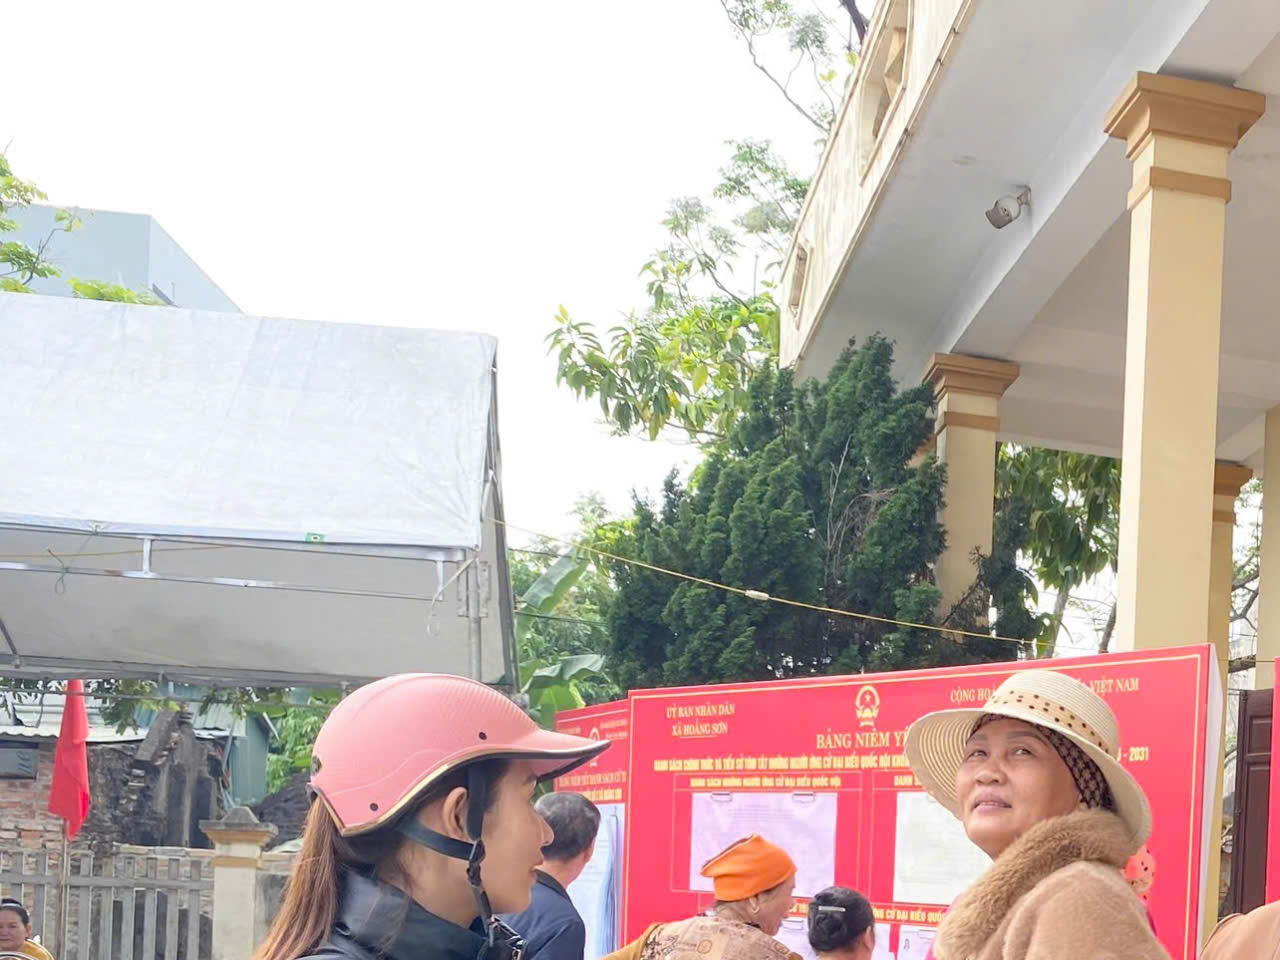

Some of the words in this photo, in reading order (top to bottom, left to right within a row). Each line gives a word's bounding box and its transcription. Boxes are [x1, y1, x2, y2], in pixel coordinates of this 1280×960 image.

[1115, 677, 1139, 692] NAM
[950, 685, 976, 704] CỘNG
[816, 728, 852, 749] BẢNG
[1129, 746, 1149, 762] 2031
